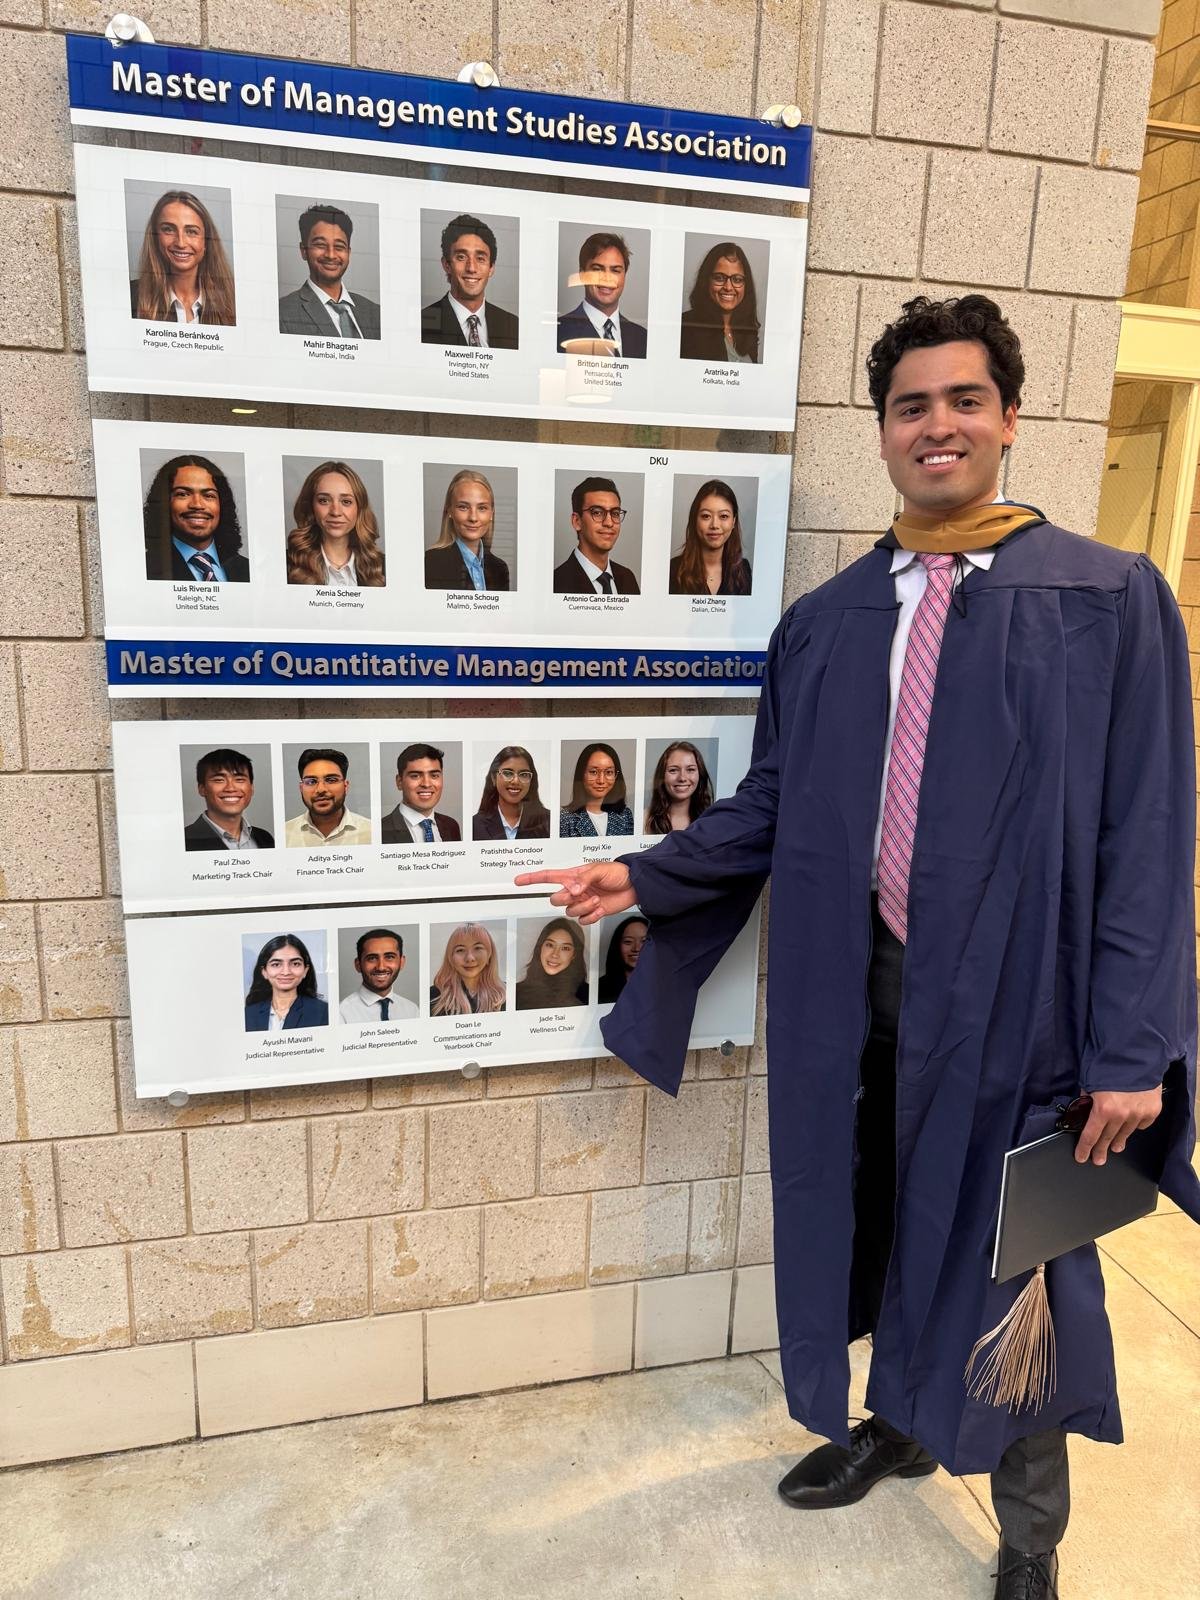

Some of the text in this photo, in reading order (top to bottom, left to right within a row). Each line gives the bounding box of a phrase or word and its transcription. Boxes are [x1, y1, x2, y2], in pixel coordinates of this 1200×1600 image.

[112, 61, 787, 166] Master of Management Studies Association
[143, 339, 225, 352] Prague, Czech Republic
[303, 340, 359, 351] Mahir Bhagtani
[308, 351, 337, 360] Mumbai,
[444, 350, 493, 360] Maxwell Forte
[449, 361, 478, 369] Irvington,
[577, 360, 629, 370] Britton Landrum
[584, 370, 614, 378] Pensacola,
[704, 368, 739, 377] Aratrika Pal
[703, 378, 725, 386] Kolkata,
[650, 456, 668, 466] DKU
[189, 585, 211, 593] Rivera
[316, 589, 361, 598] Xenia Scheer
[177, 595, 204, 603] Raleigh,
[446, 593, 500, 603] Johanna Schoug
[563, 595, 588, 603] Antonio
[607, 596, 630, 604] Estrada
[692, 597, 726, 606] Kaixi Zhang
[309, 600, 334, 609] Munich,
[446, 602, 500, 611] Malmö, Sweden
[568, 604, 602, 612] Cuernavaca,
[691, 606, 709, 614] Dalian,
[119, 649, 225, 676] Master
[232, 649, 263, 676] of
[270, 650, 449, 679] Quantitative
[456, 654, 627, 682] Management
[583, 844, 600, 852] Jingyi
[307, 854, 353, 863] Aditya Singh
[380, 852, 411, 860] Santiago
[431, 849, 466, 858] Rodriguez
[231, 858, 250, 866] Zhao
[413, 863, 430, 871] Track
[431, 862, 449, 870] Chair
[480, 860, 508, 868] Strategy
[192, 873, 231, 881] Marketing
[360, 1028, 400, 1038] John Saleeb
[529, 1026, 557, 1034] Wellness
[262, 1035, 313, 1048] Ayushi Mavani
[433, 1032, 488, 1043] Communications
[342, 1039, 418, 1053] Judicial Representative
[444, 1043, 474, 1051] Yearbook
[246, 1047, 325, 1060] Judicial Representative
